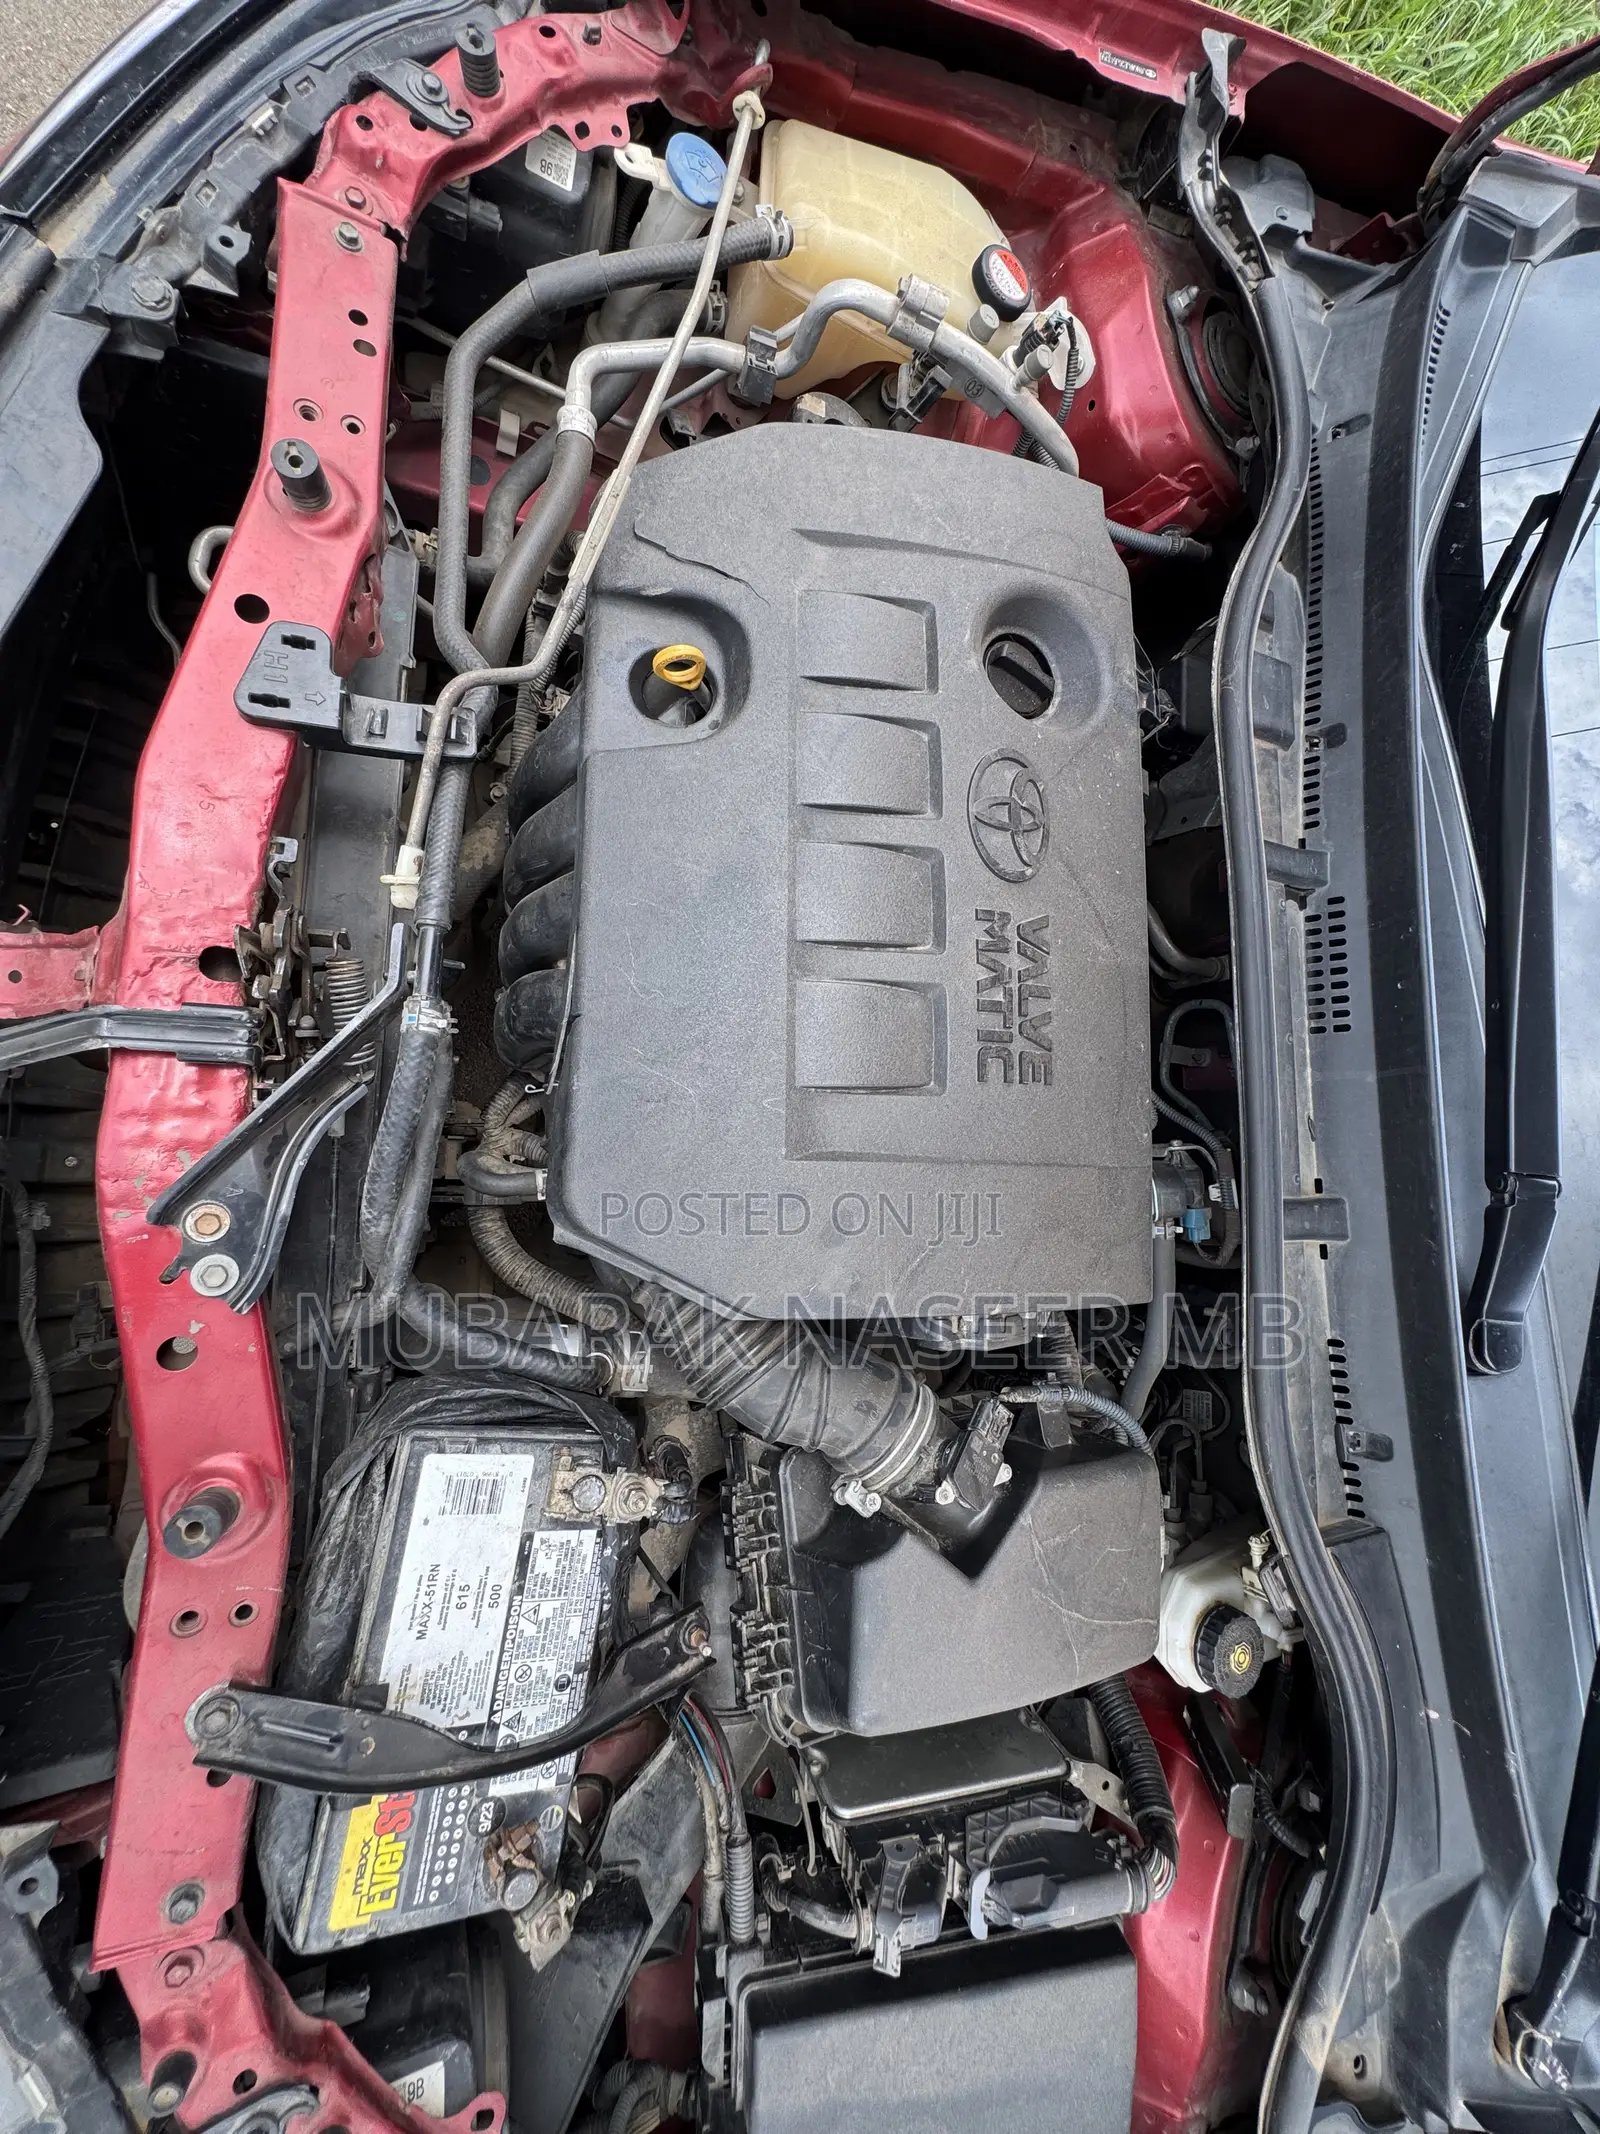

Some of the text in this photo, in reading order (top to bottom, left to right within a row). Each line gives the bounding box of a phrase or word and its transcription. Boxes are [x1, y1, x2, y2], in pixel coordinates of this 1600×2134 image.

[539, 158, 553, 176] 9B
[263, 650, 288, 683] H1
[975, 908, 1014, 1084] MATIC
[1017, 915, 1052, 1086] VALVE
[415, 1563, 440, 1640] MAXX-51RN
[455, 1583, 470, 1609] 615
[488, 1583, 502, 1608] 500
[495, 1595, 522, 1710] DANGER/POISON
[478, 1800, 494, 1832] 9/23
[353, 1838, 373, 1894] maxx
[357, 1790, 415, 1915] EverSt
